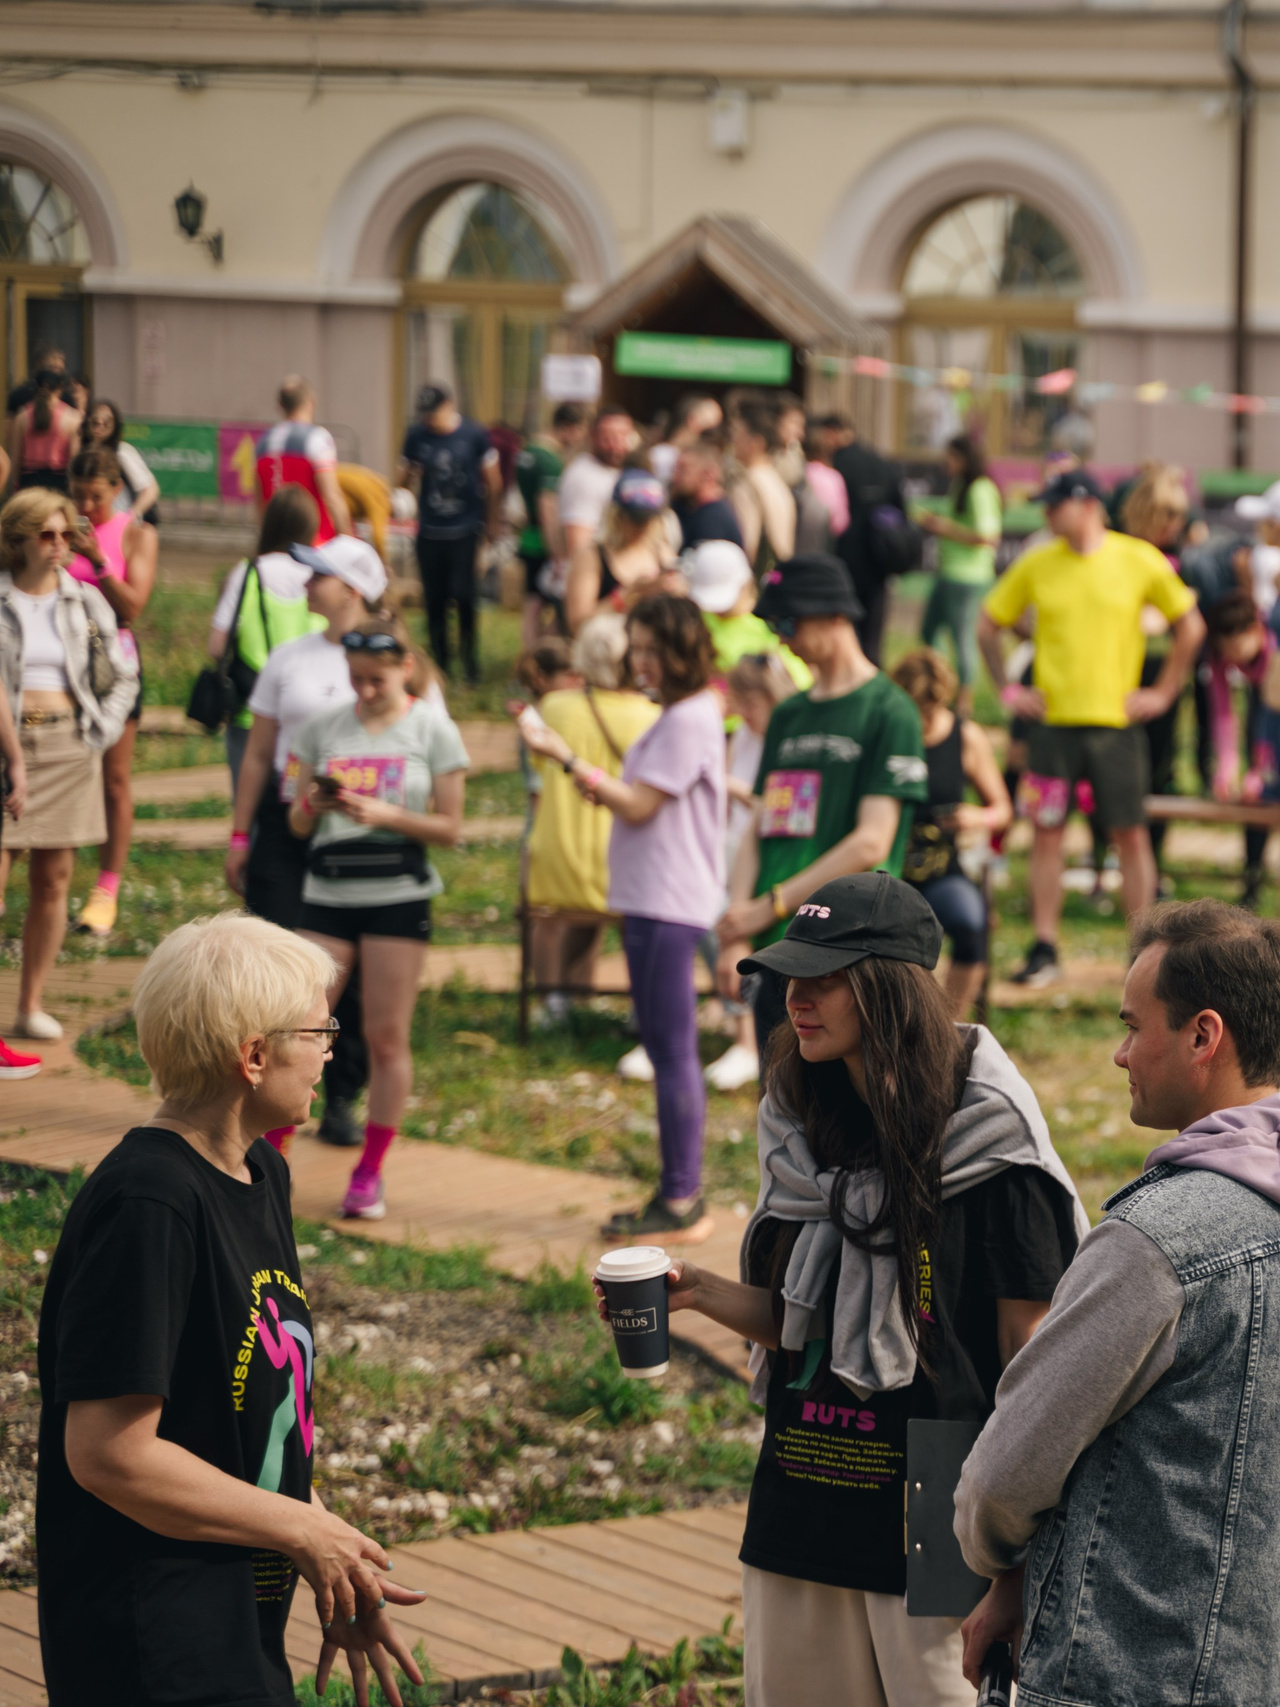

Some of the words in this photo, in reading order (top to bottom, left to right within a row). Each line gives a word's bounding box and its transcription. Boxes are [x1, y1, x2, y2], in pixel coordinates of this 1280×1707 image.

[796, 904, 831, 918] UTS
[919, 1242, 931, 1315] ERIES
[612, 1316, 649, 1328] FIELDS
[801, 1400, 876, 1431] RUTS
